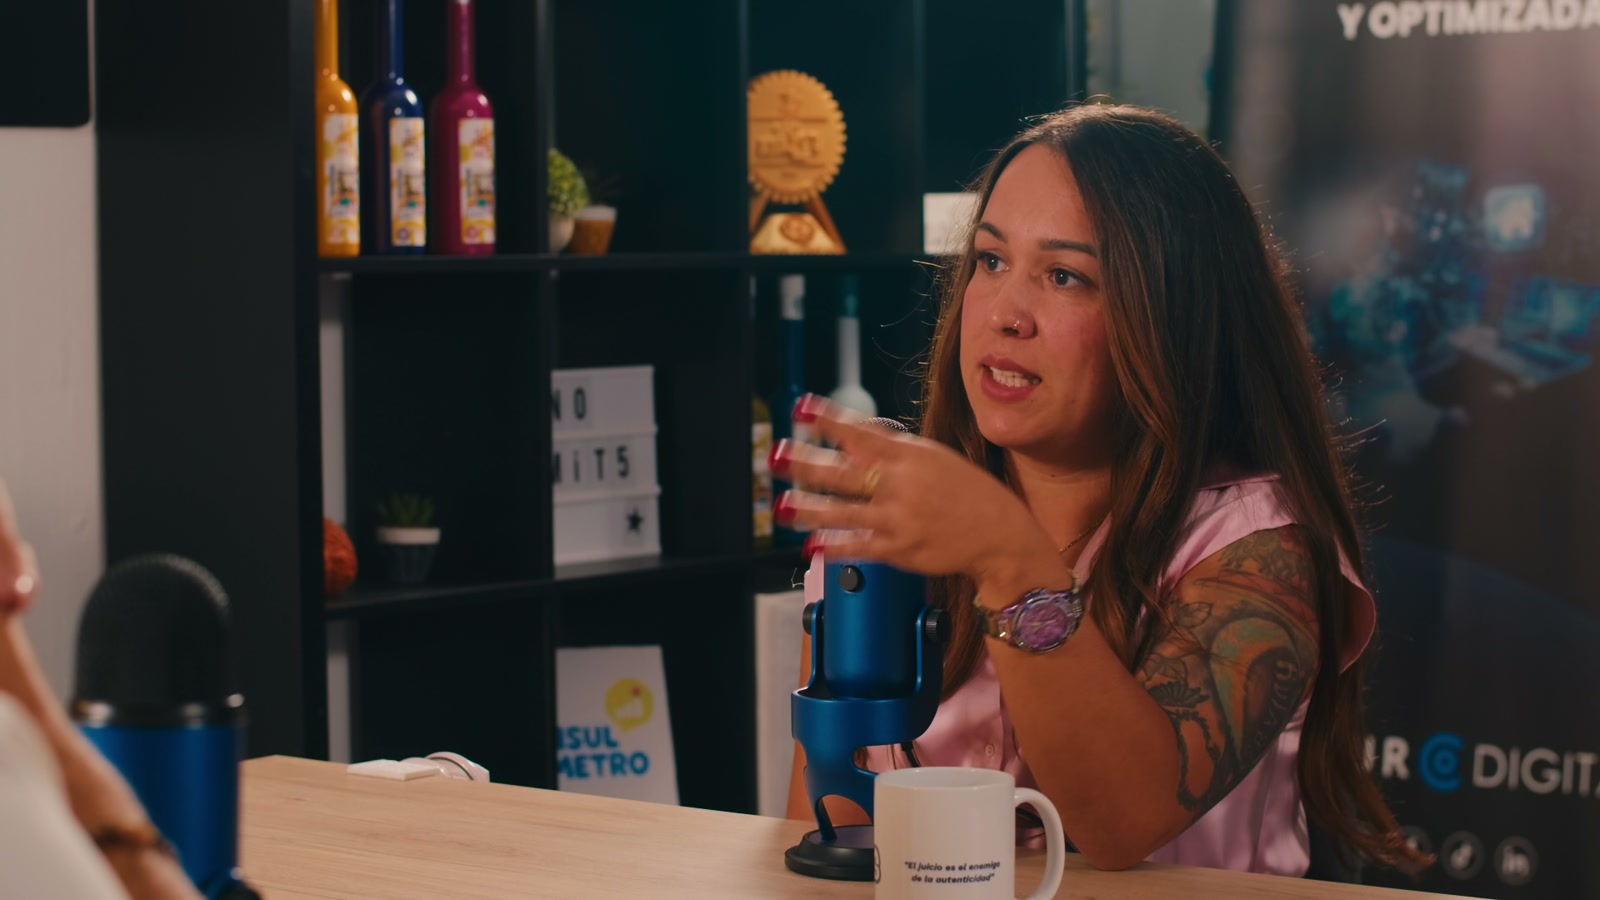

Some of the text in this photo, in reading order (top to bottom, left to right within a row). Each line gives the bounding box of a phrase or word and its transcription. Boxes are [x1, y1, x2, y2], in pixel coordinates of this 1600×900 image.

[1337, 3, 1365, 40] Y
[1472, 743, 1600, 797] DIGIT
[911, 874, 922, 882] de
[924, 875, 934, 883] la
[917, 863, 943, 872] juicio
[958, 863, 967, 871] el
[968, 861, 1000, 870] enemigo
